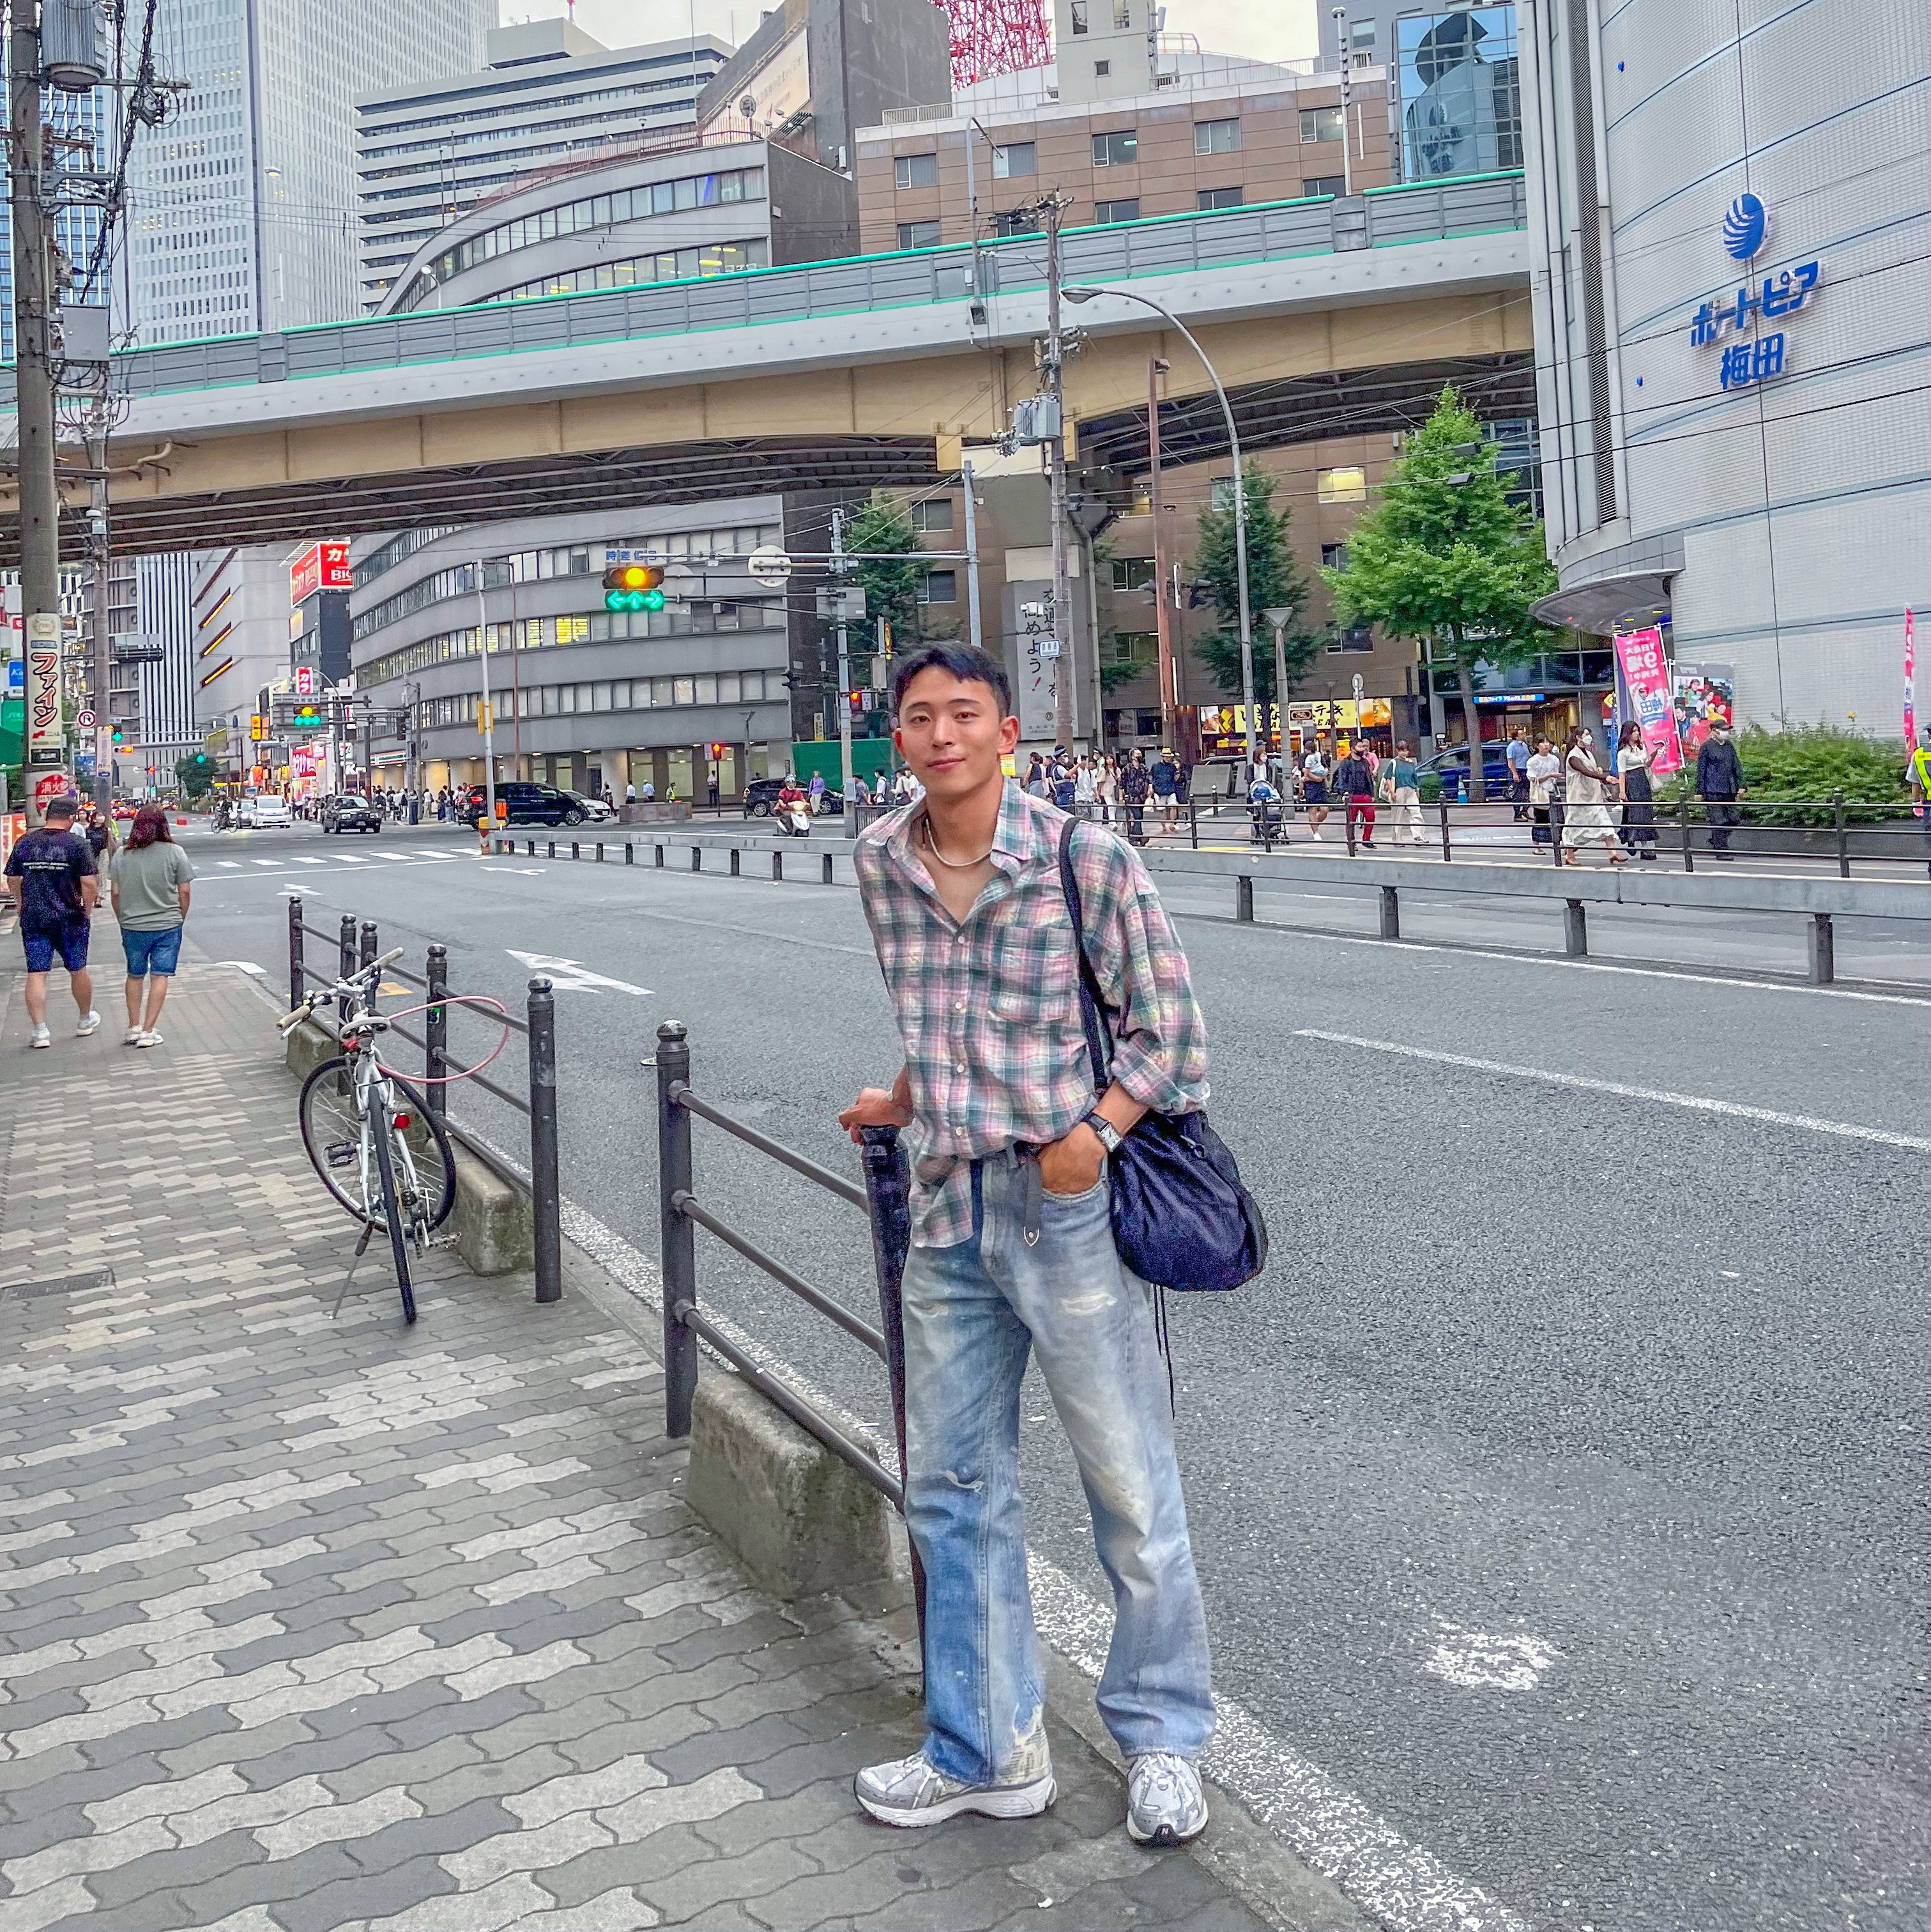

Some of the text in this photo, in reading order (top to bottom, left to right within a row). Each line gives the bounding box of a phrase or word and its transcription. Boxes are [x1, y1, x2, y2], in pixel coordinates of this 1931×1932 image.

[1691, 261, 1819, 348] ボートピア
[1720, 332, 1785, 390] 梅田
[32, 652, 57, 728] ファイン
[1162, 1827, 1169, 1836] N
